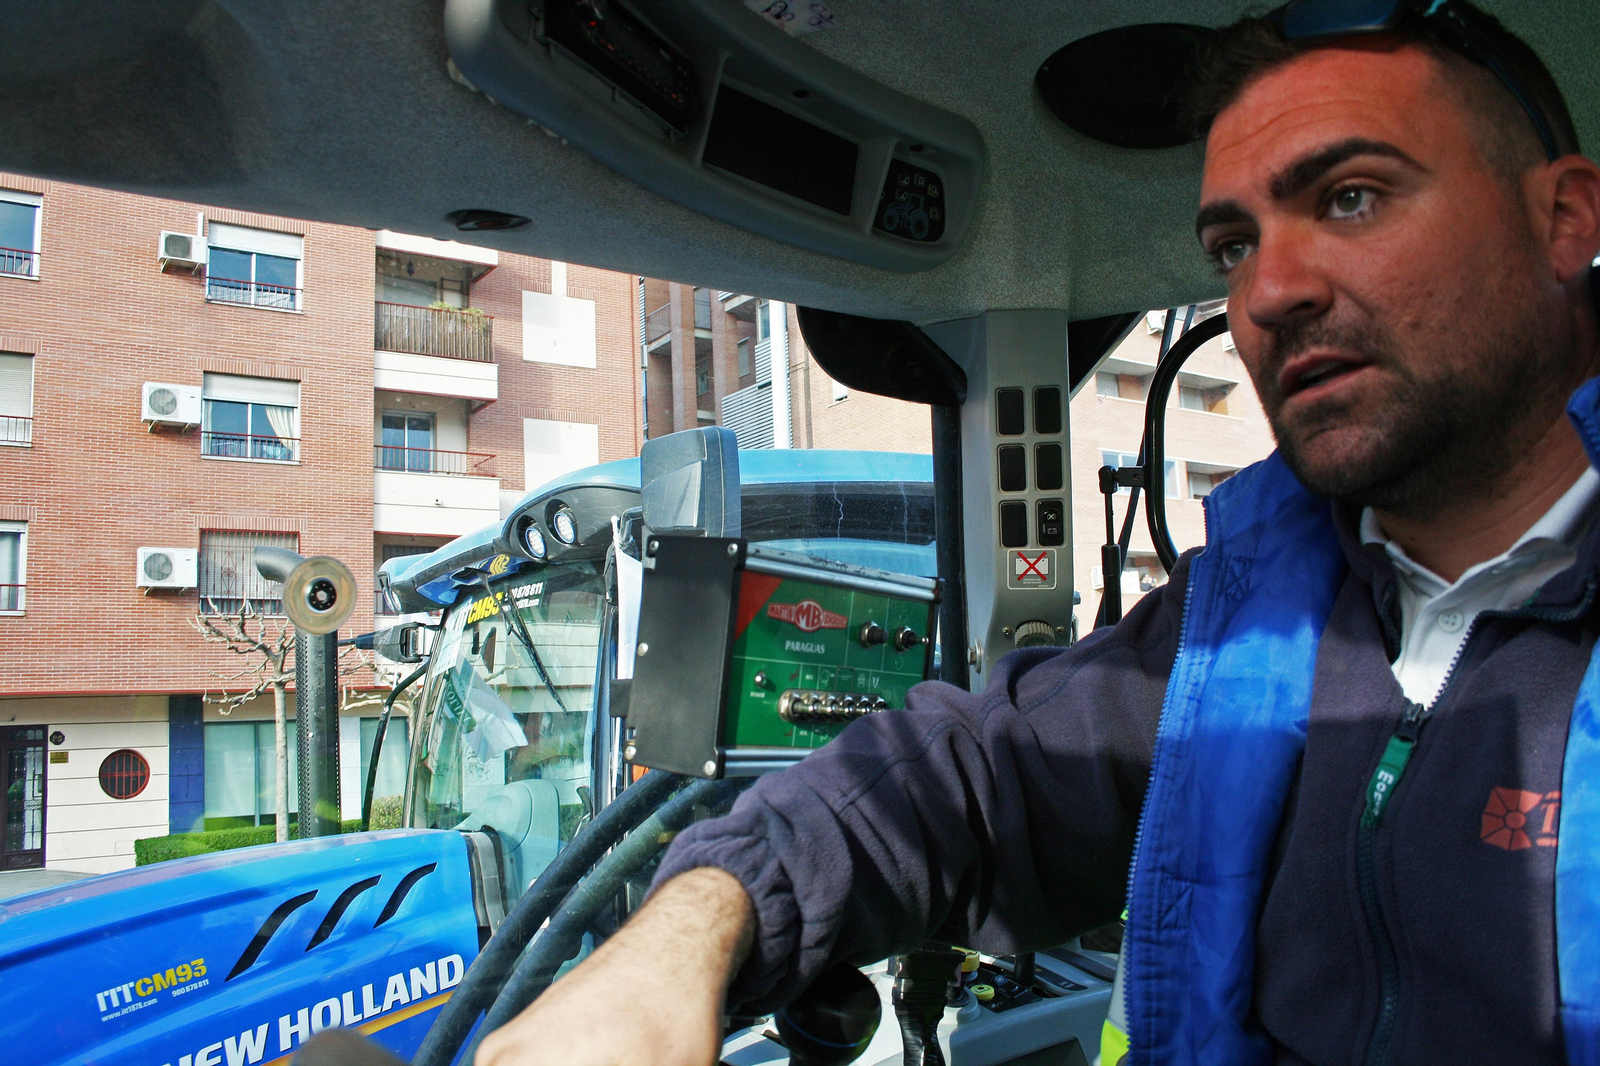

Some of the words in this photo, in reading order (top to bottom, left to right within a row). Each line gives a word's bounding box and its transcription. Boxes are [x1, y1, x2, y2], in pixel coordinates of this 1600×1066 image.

[797, 602, 822, 629] MB
[785, 640, 826, 654] PARAGUAS
[96, 958, 207, 1012] ITTCM93
[278, 953, 466, 1053] HOLLAND
